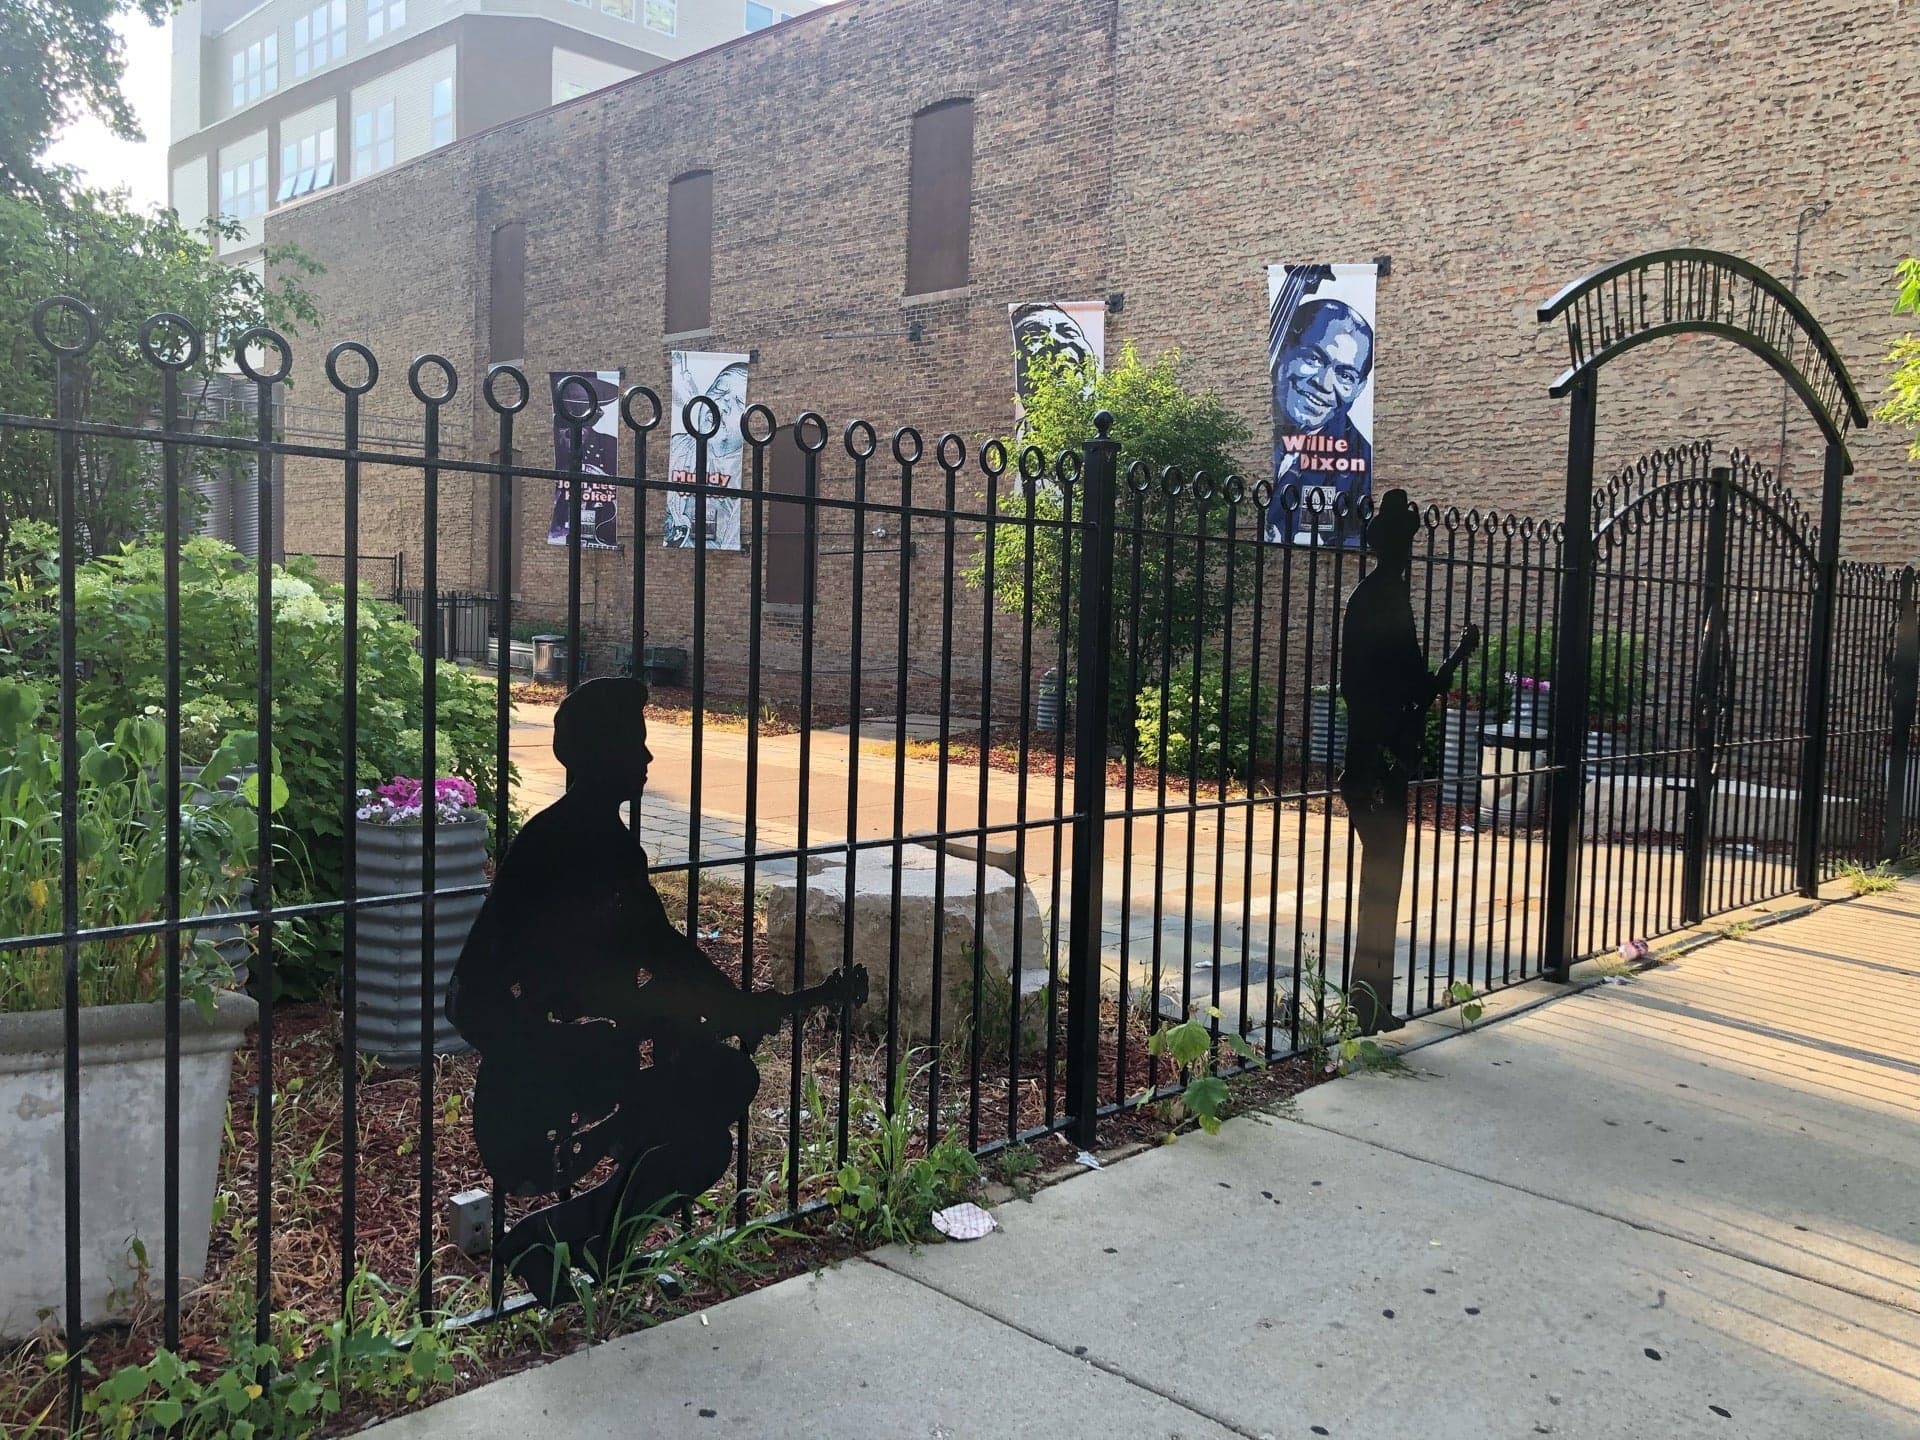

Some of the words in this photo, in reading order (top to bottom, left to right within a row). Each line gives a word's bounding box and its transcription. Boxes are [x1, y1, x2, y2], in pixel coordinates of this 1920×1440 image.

[1565, 265, 1650, 371] WILLIE
[1282, 434, 1348, 452] Willie
[1300, 453, 1366, 472] Dixon
[672, 470, 731, 488] Mudy
